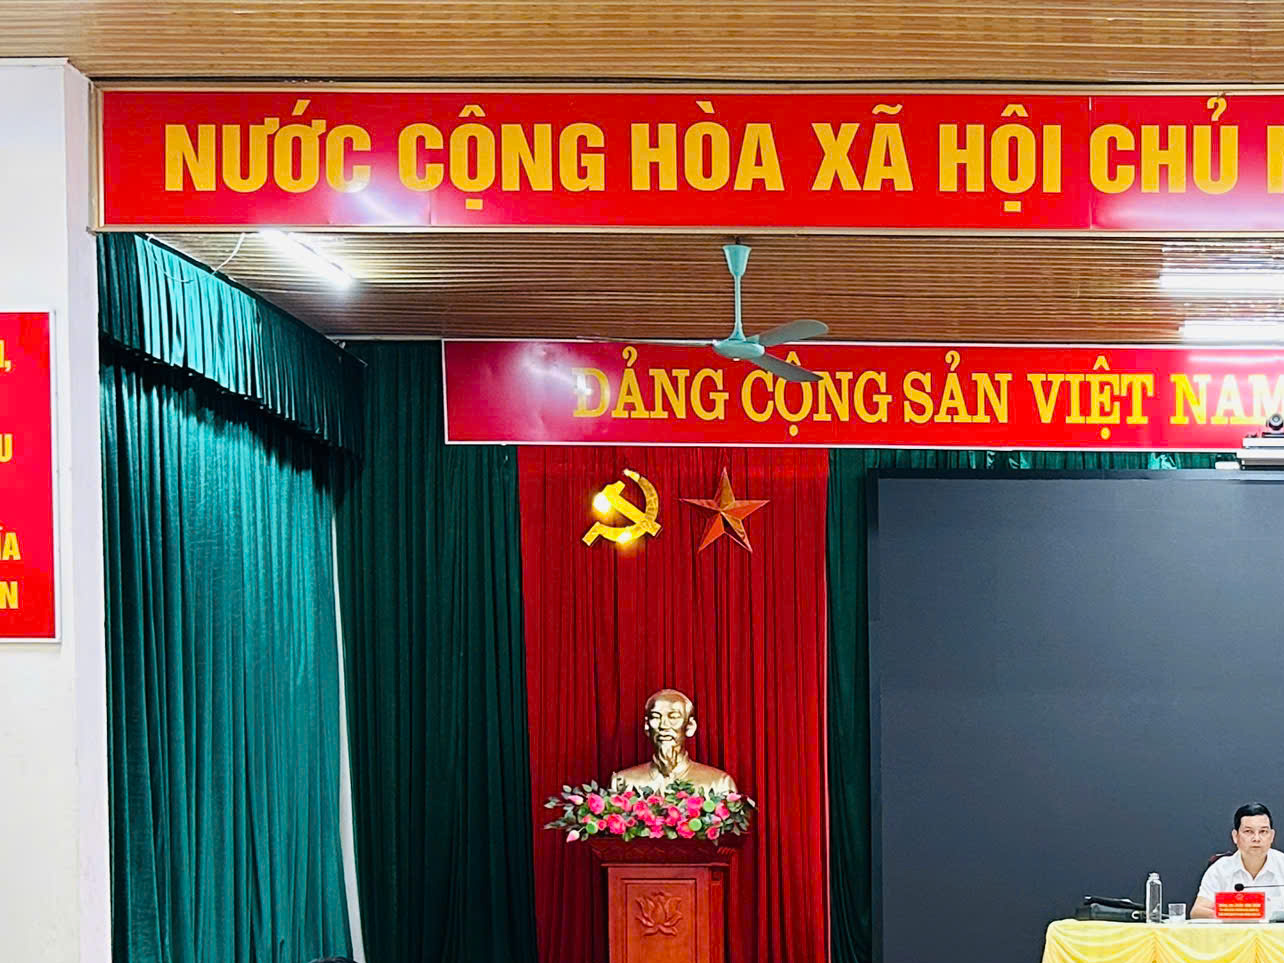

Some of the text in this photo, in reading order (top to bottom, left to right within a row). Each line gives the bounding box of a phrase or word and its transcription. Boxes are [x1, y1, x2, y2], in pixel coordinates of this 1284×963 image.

[164, 99, 371, 193] NƯỚC
[398, 104, 605, 210] CỘNG
[631, 101, 785, 191] HÒA
[812, 103, 913, 191] XÃ
[939, 103, 1062, 212] HỘI
[1089, 97, 1239, 195] CHỦ
[573, 346, 729, 421] ĐẢNG
[741, 351, 892, 437] CỘNG
[903, 351, 1013, 424] SẢN
[1026, 355, 1155, 440] VIỆT
